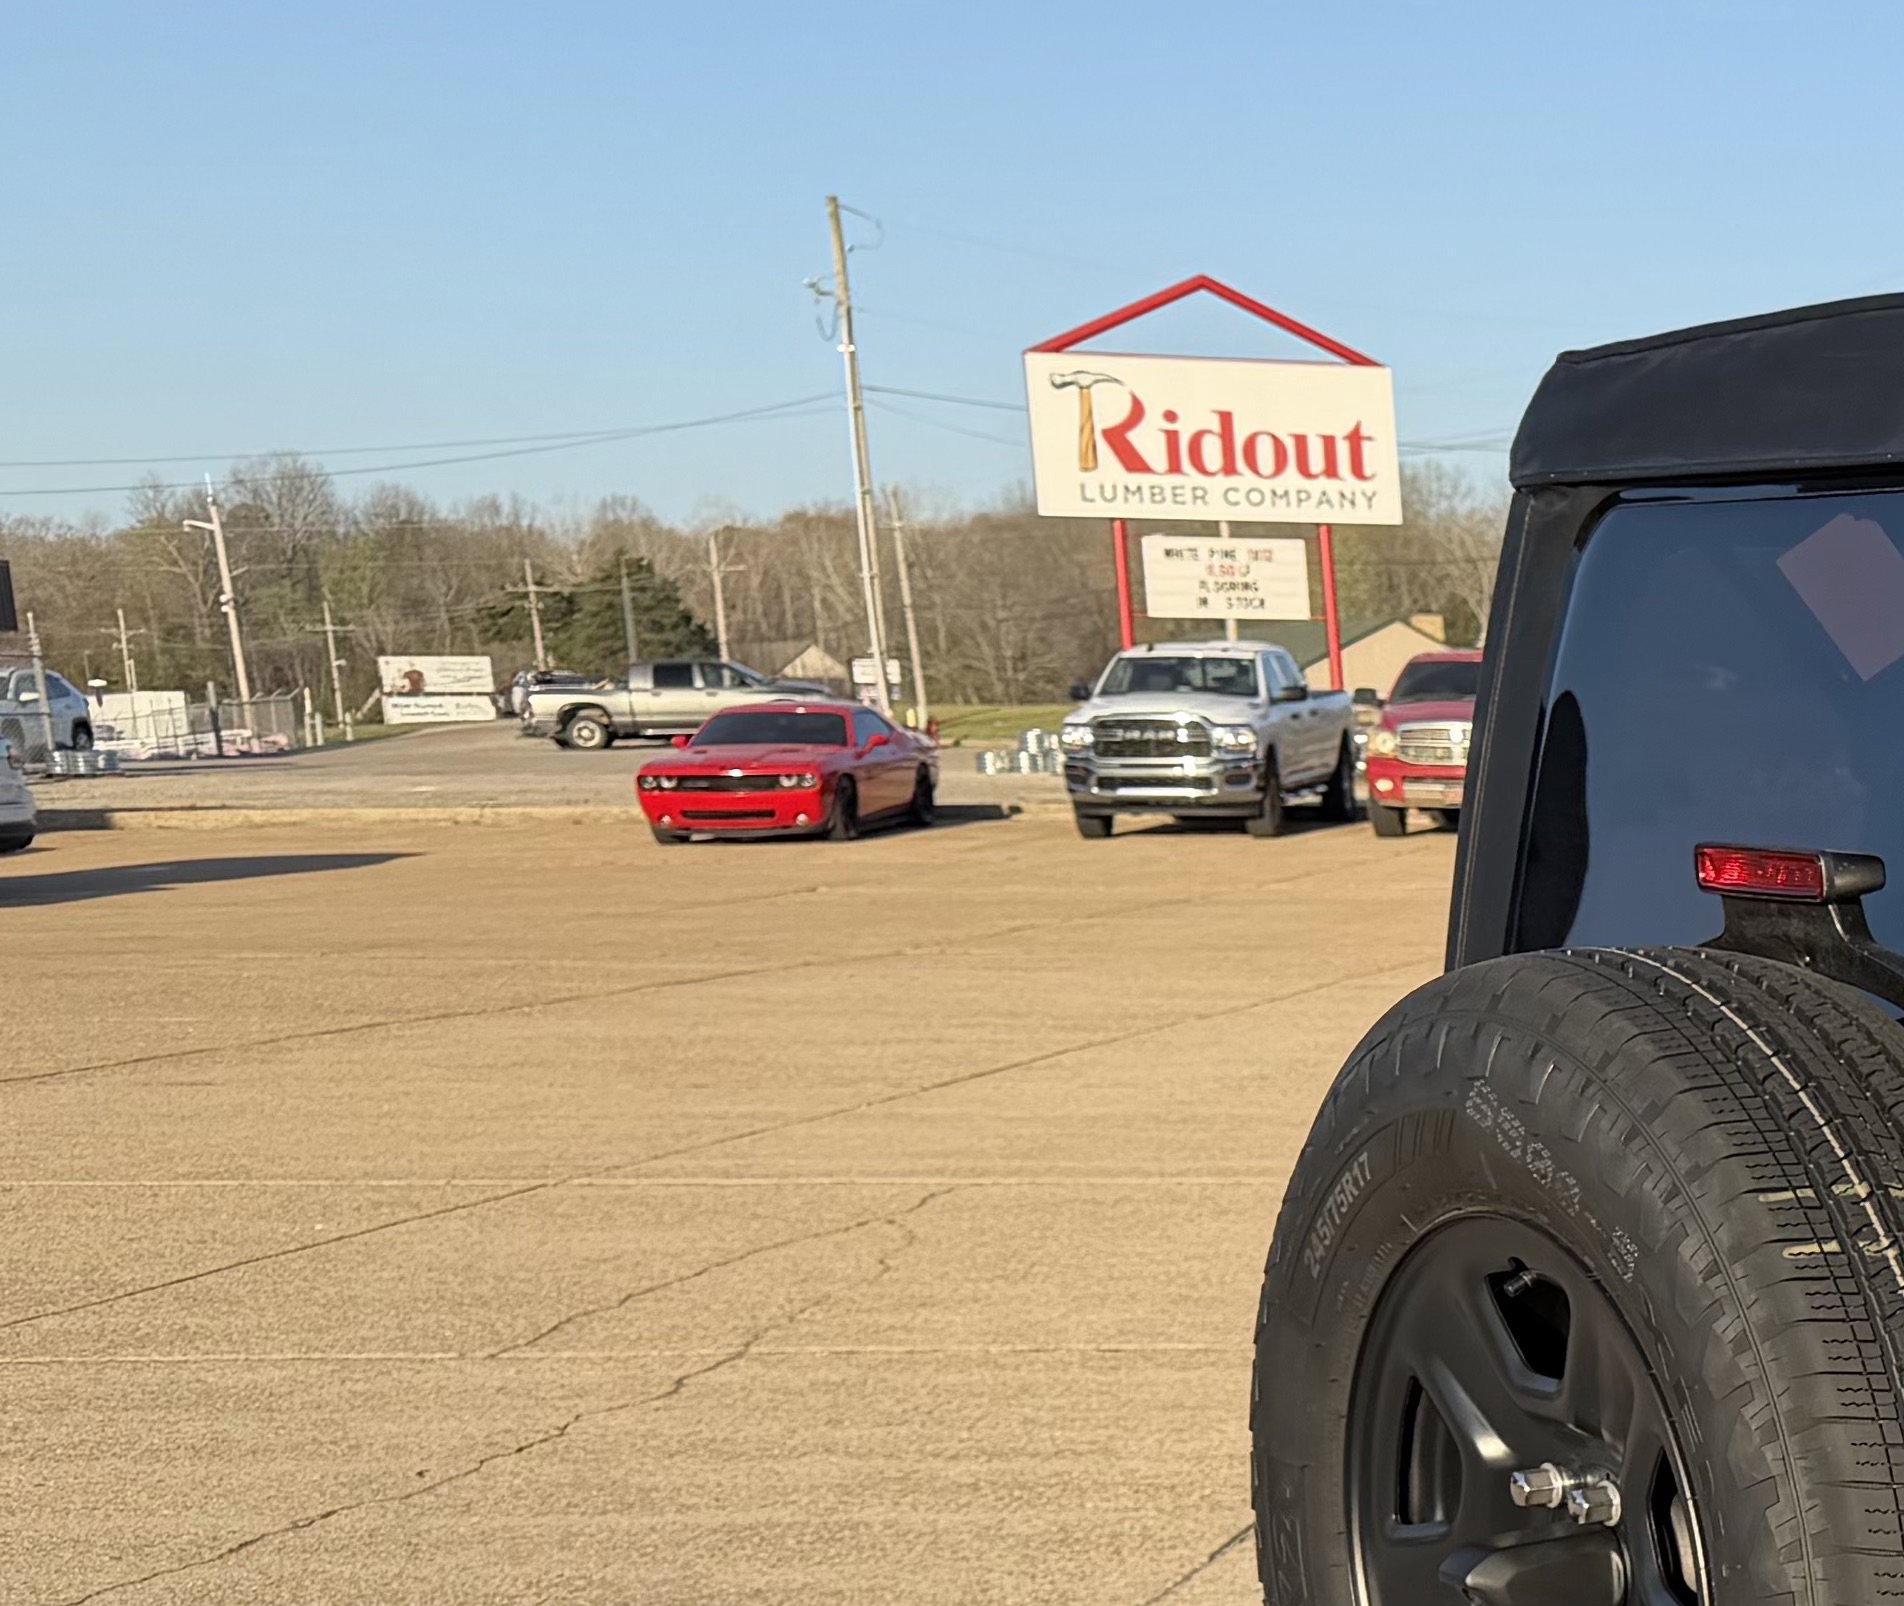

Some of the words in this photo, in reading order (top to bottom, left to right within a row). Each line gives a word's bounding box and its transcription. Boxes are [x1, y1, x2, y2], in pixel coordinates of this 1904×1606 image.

[1062, 372, 1377, 482] Ridout
[1079, 482, 1209, 506] LUMBER
[1222, 486, 1378, 510] COMPANY
[1304, 1151, 1372, 1280] 245/75R17
